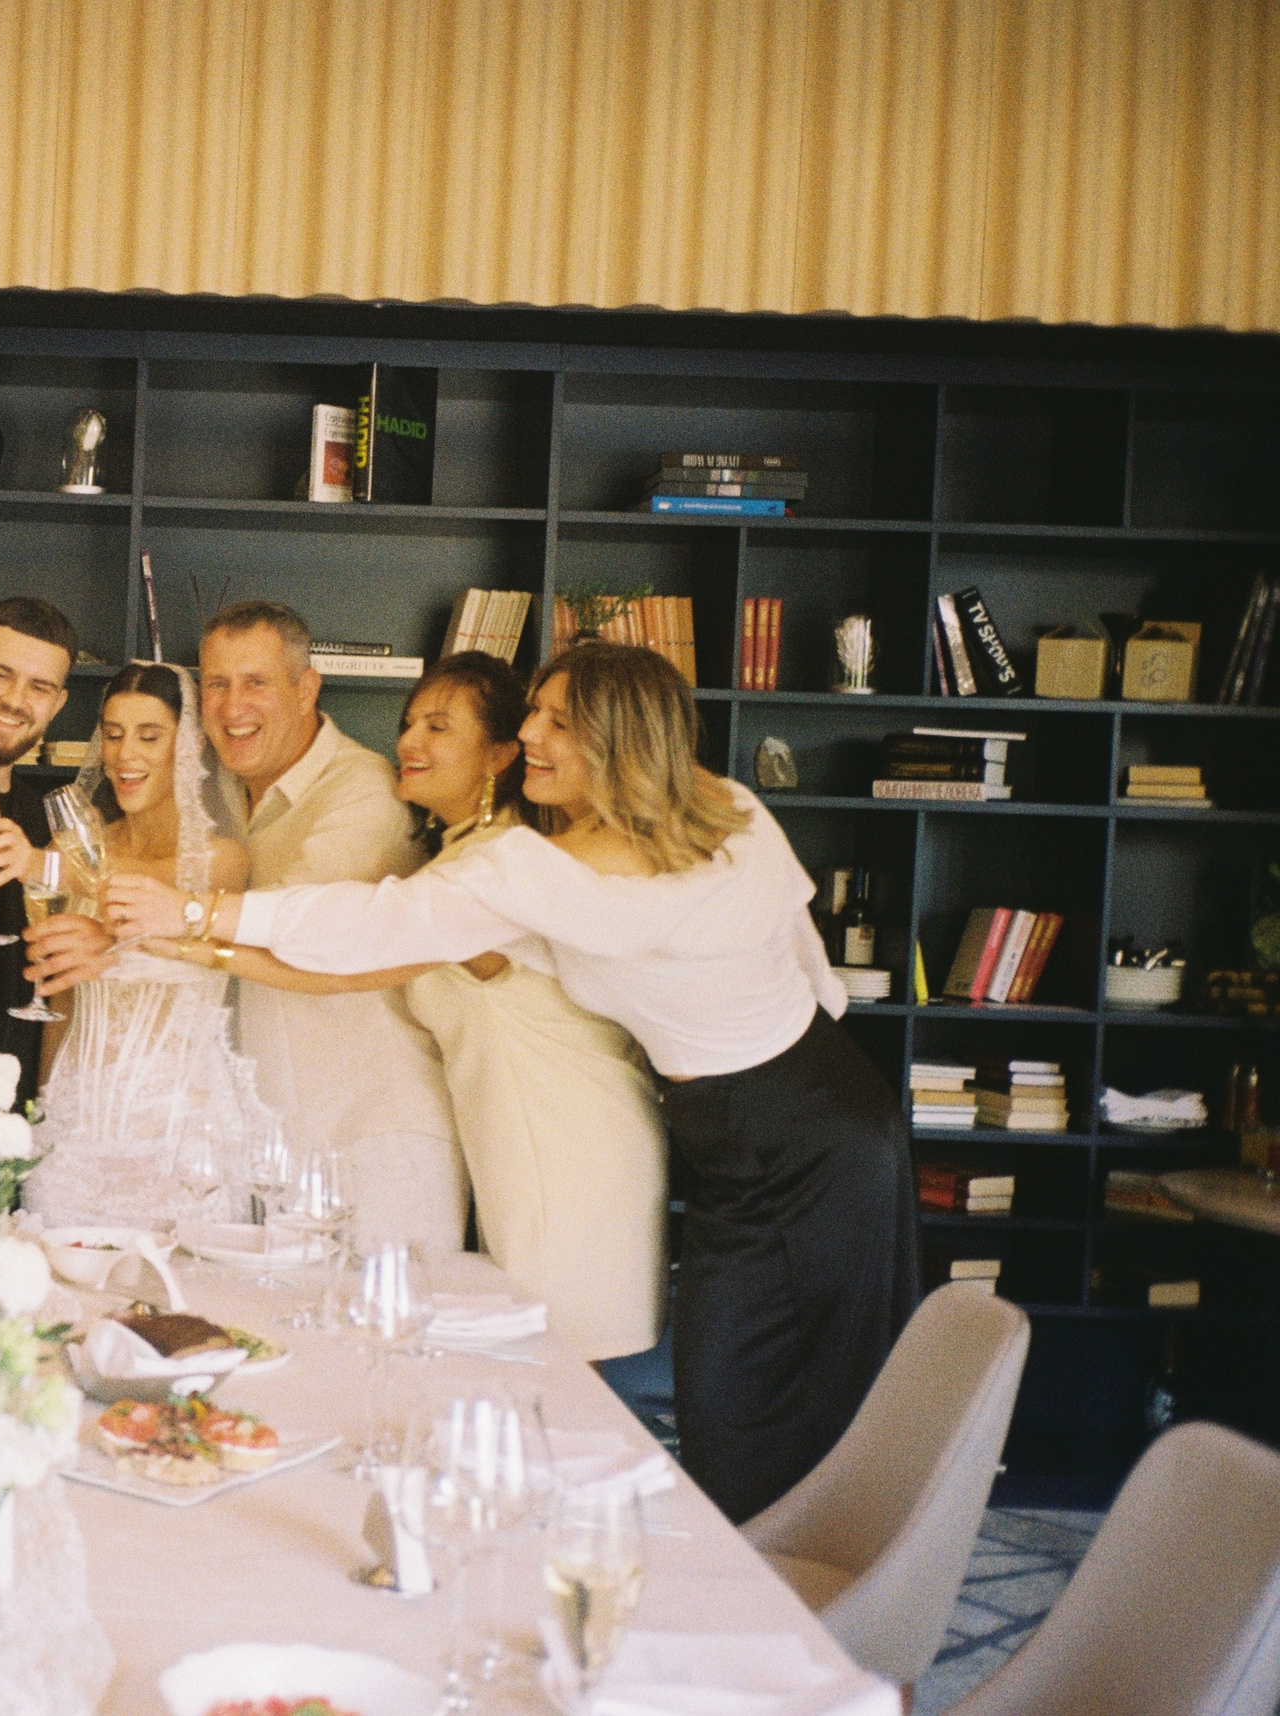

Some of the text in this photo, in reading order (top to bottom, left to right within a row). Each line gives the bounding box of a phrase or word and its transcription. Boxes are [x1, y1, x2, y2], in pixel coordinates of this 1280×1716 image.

[356, 396, 370, 469] HADID
[376, 414, 428, 440] HADID
[968, 600, 989, 623] TV
[324, 660, 386, 671] MAGRITTE
